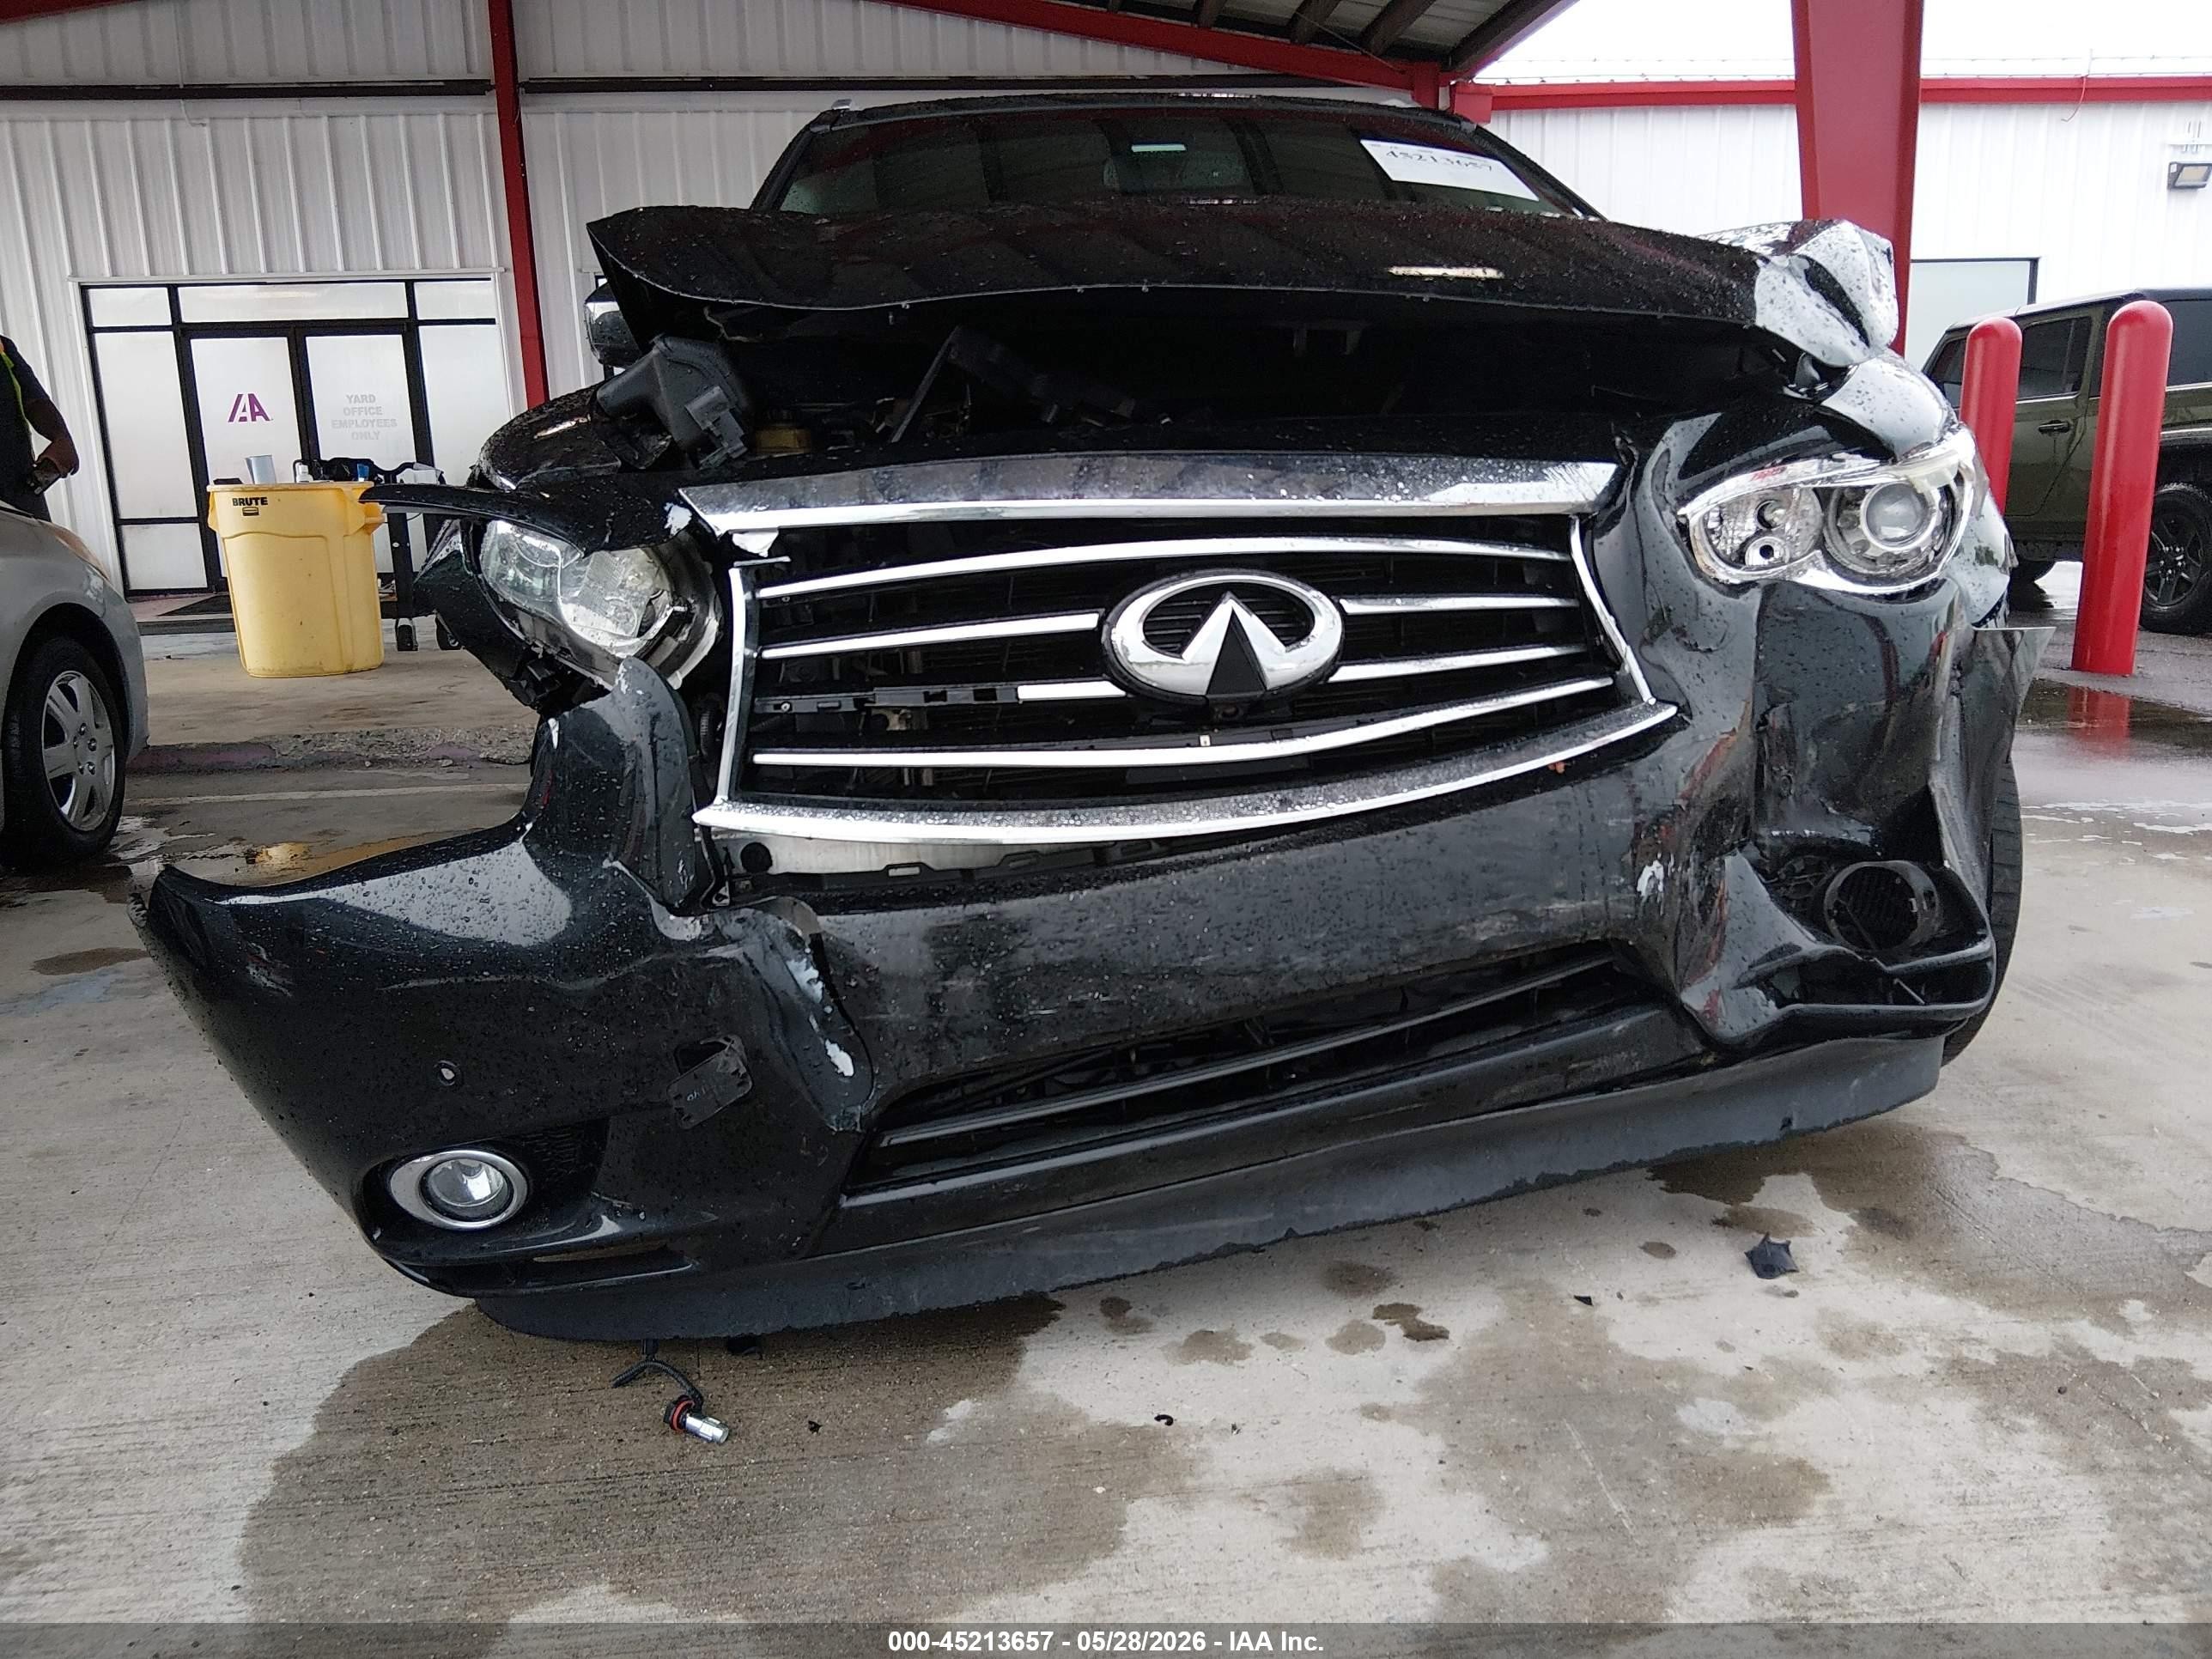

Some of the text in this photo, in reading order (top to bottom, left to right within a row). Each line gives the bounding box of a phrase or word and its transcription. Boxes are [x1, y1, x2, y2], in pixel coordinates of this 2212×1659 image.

[346, 394, 376, 404] YARD
[343, 406, 383, 416] OFFICE
[331, 418, 398, 429] EMPLOYEES
[351, 431, 380, 441] ONLY
[233, 496, 268, 507] BRUTE
